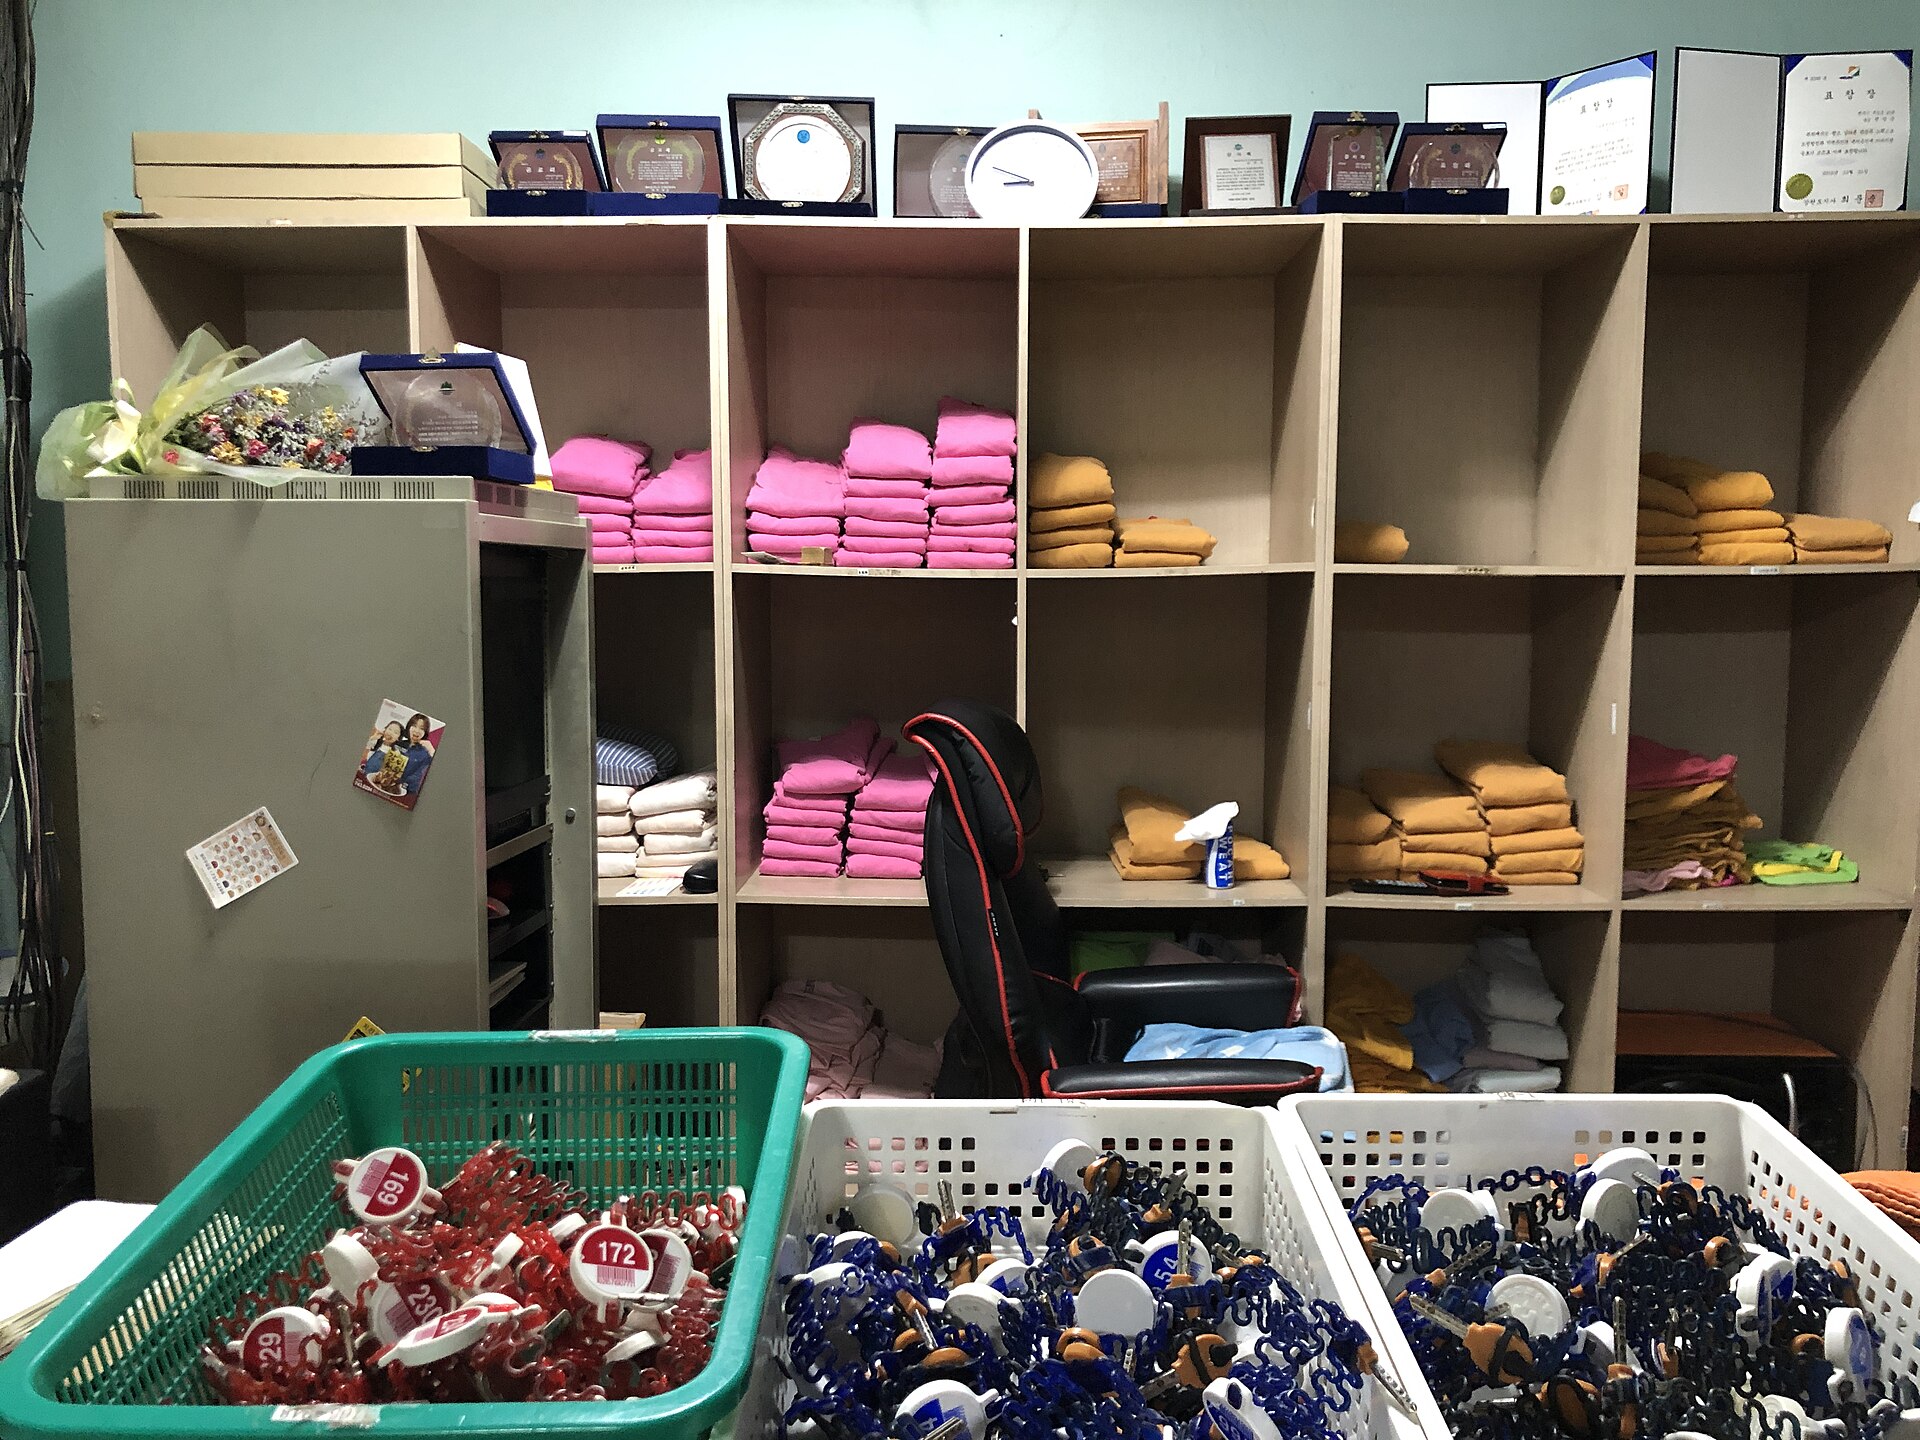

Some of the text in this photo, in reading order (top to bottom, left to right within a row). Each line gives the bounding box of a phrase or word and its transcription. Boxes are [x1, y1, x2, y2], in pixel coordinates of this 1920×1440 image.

[1218, 837, 1228, 881] WEAT
[377, 1171, 410, 1206] 169
[598, 1240, 636, 1265] 172
